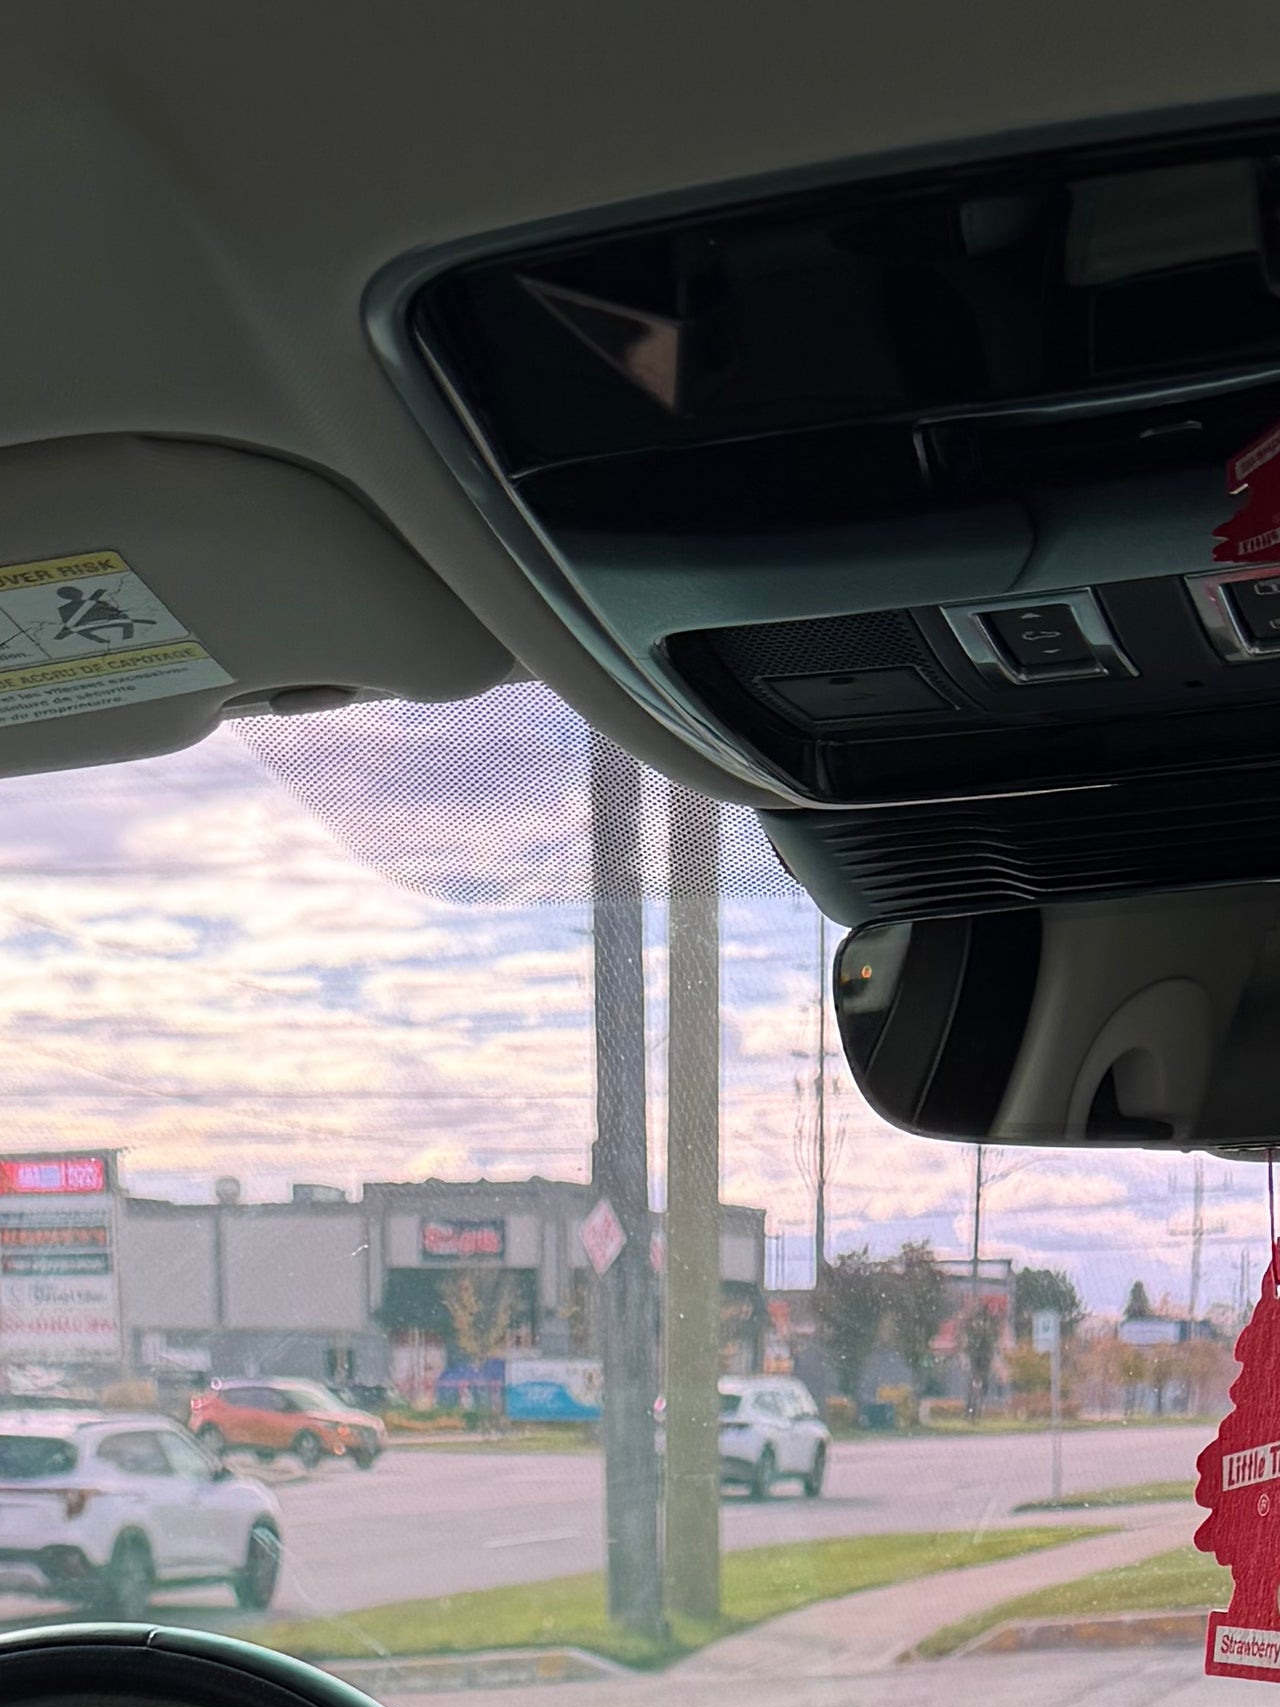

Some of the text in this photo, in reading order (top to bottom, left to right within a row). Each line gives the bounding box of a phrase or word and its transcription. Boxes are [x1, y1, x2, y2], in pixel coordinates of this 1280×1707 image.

[57, 558, 118, 579] RISK
[20, 666, 80, 686] ACCRU
[80, 662, 105, 675] DE
[107, 648, 200, 670] CAPOTAGE
[1227, 1452, 1266, 1487] Little
